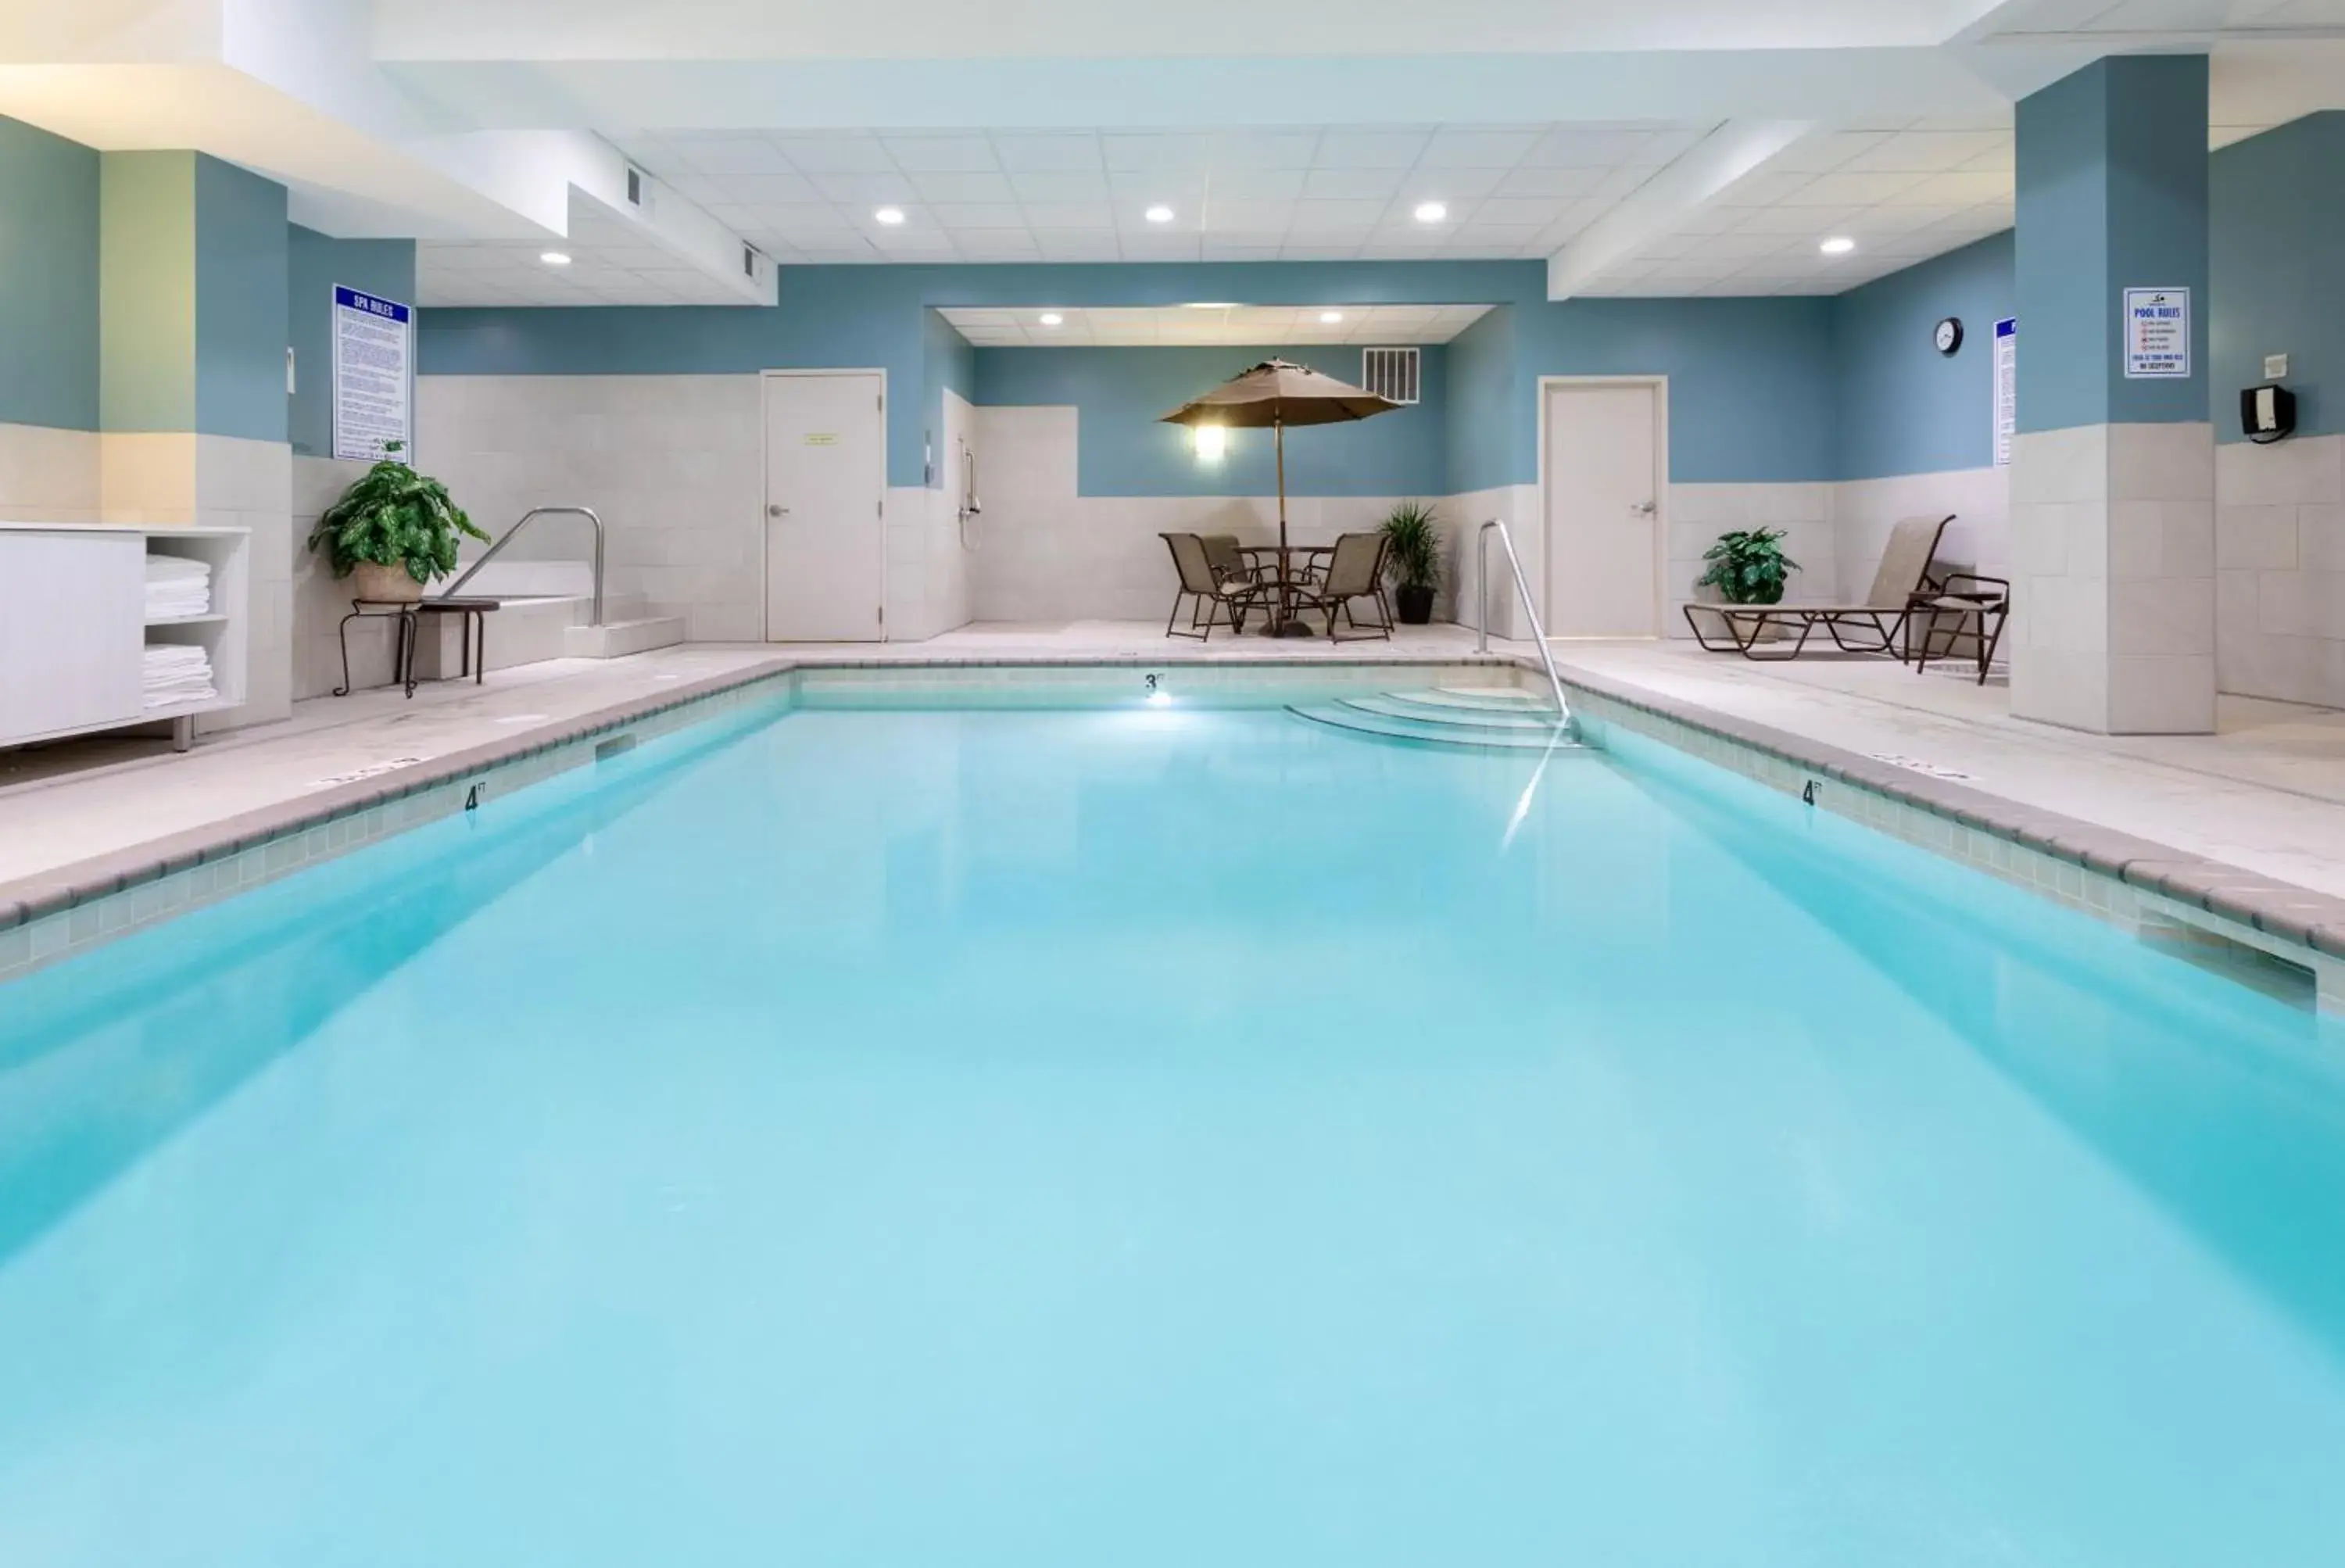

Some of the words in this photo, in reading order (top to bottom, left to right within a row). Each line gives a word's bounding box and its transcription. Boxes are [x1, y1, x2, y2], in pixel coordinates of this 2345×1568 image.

[354, 295, 368, 310] SPA
[371, 299, 393, 317] RULES
[2134, 307, 2154, 319] POOL
[2158, 307, 2180, 319] RULES
